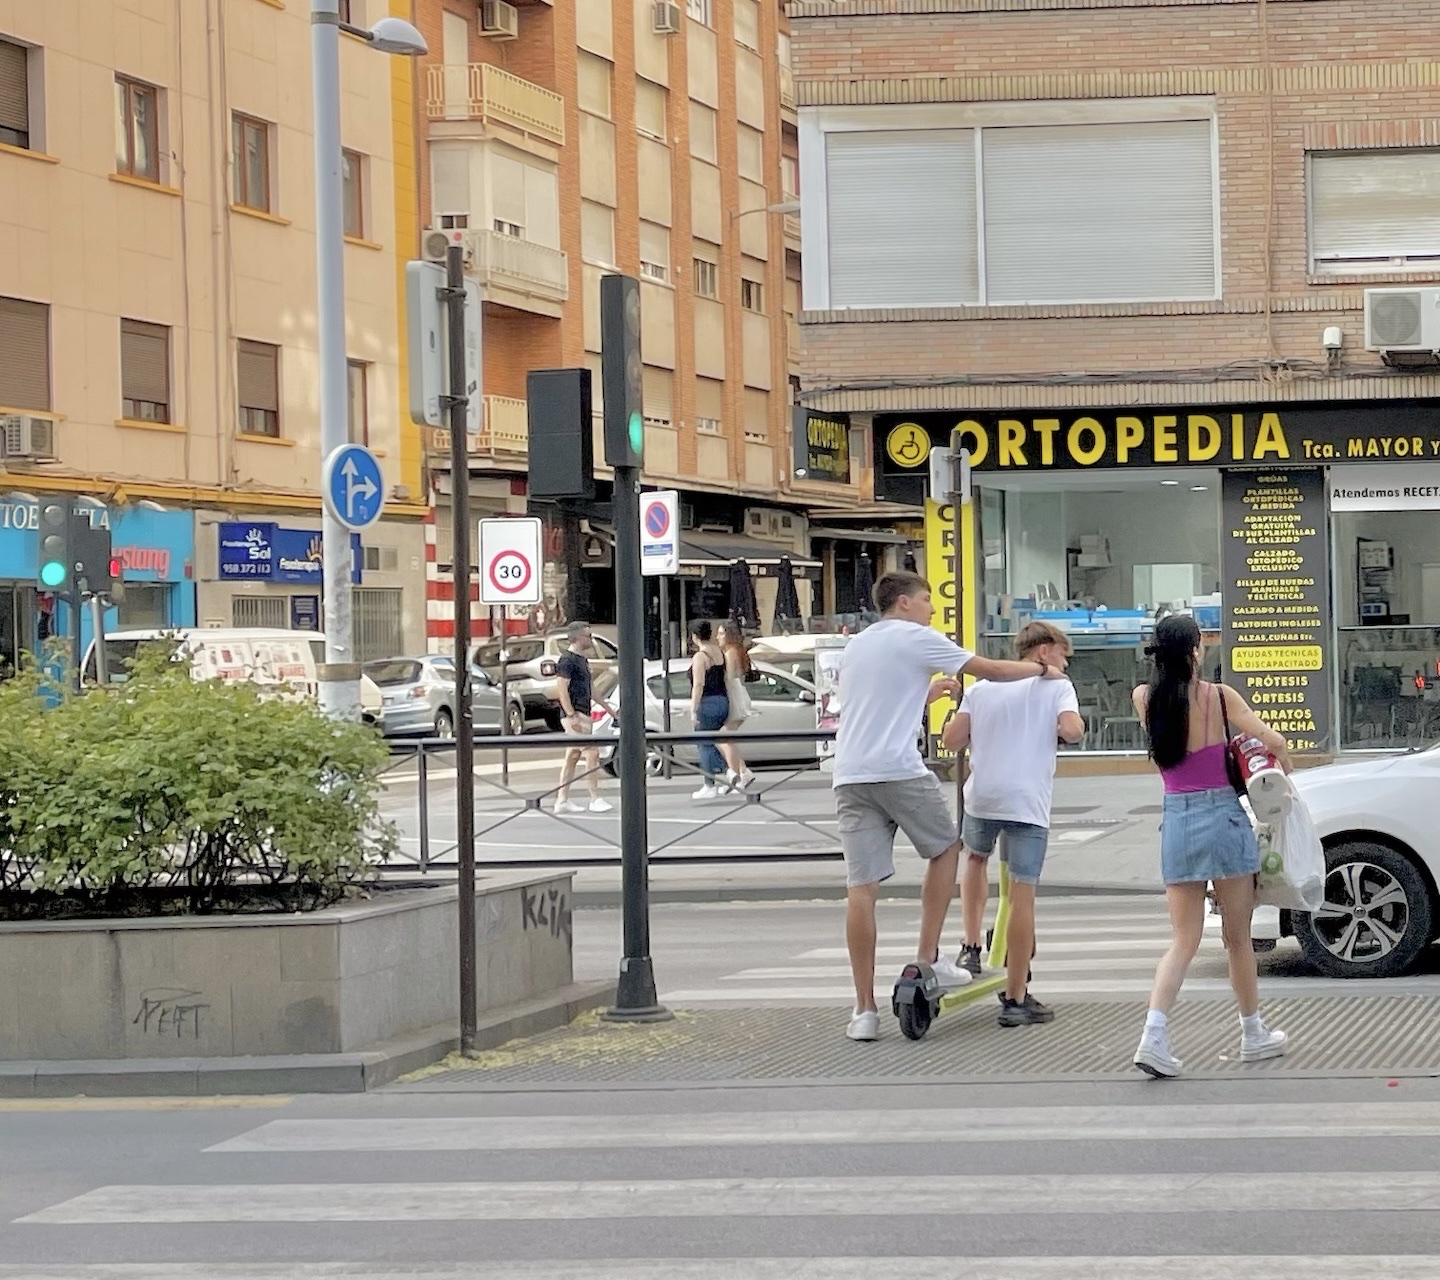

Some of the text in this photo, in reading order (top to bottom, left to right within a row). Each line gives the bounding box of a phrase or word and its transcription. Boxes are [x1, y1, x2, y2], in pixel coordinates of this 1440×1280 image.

[957, 412, 1290, 467] ORTOPEDIA
[1303, 440, 1340, 458] Tca.
[1347, 437, 1424, 457] MAYOR
[1431, 440, 1440, 455] Y
[1333, 487, 1400, 499] Atendemos
[1251, 522, 1295, 530] GRATUITA
[1232, 530, 1244, 538] DE
[1263, 528, 1316, 537] PLANTILLAS
[1259, 536, 1300, 544] CALZADO
[249, 547, 271, 560] Sol
[499, 565, 522, 579] 30
[1250, 564, 1300, 572] EXCLUSIVO
[1233, 606, 1275, 615] CALZADO
[1284, 605, 1319, 613] MEDIDA
[1236, 650, 1272, 659] AYUDAS
[1236, 659, 1318, 669] A DISCAPACITADO
[1246, 674, 1308, 688] PRÓTESIS
[1251, 691, 1305, 704] ÓRTESIS
